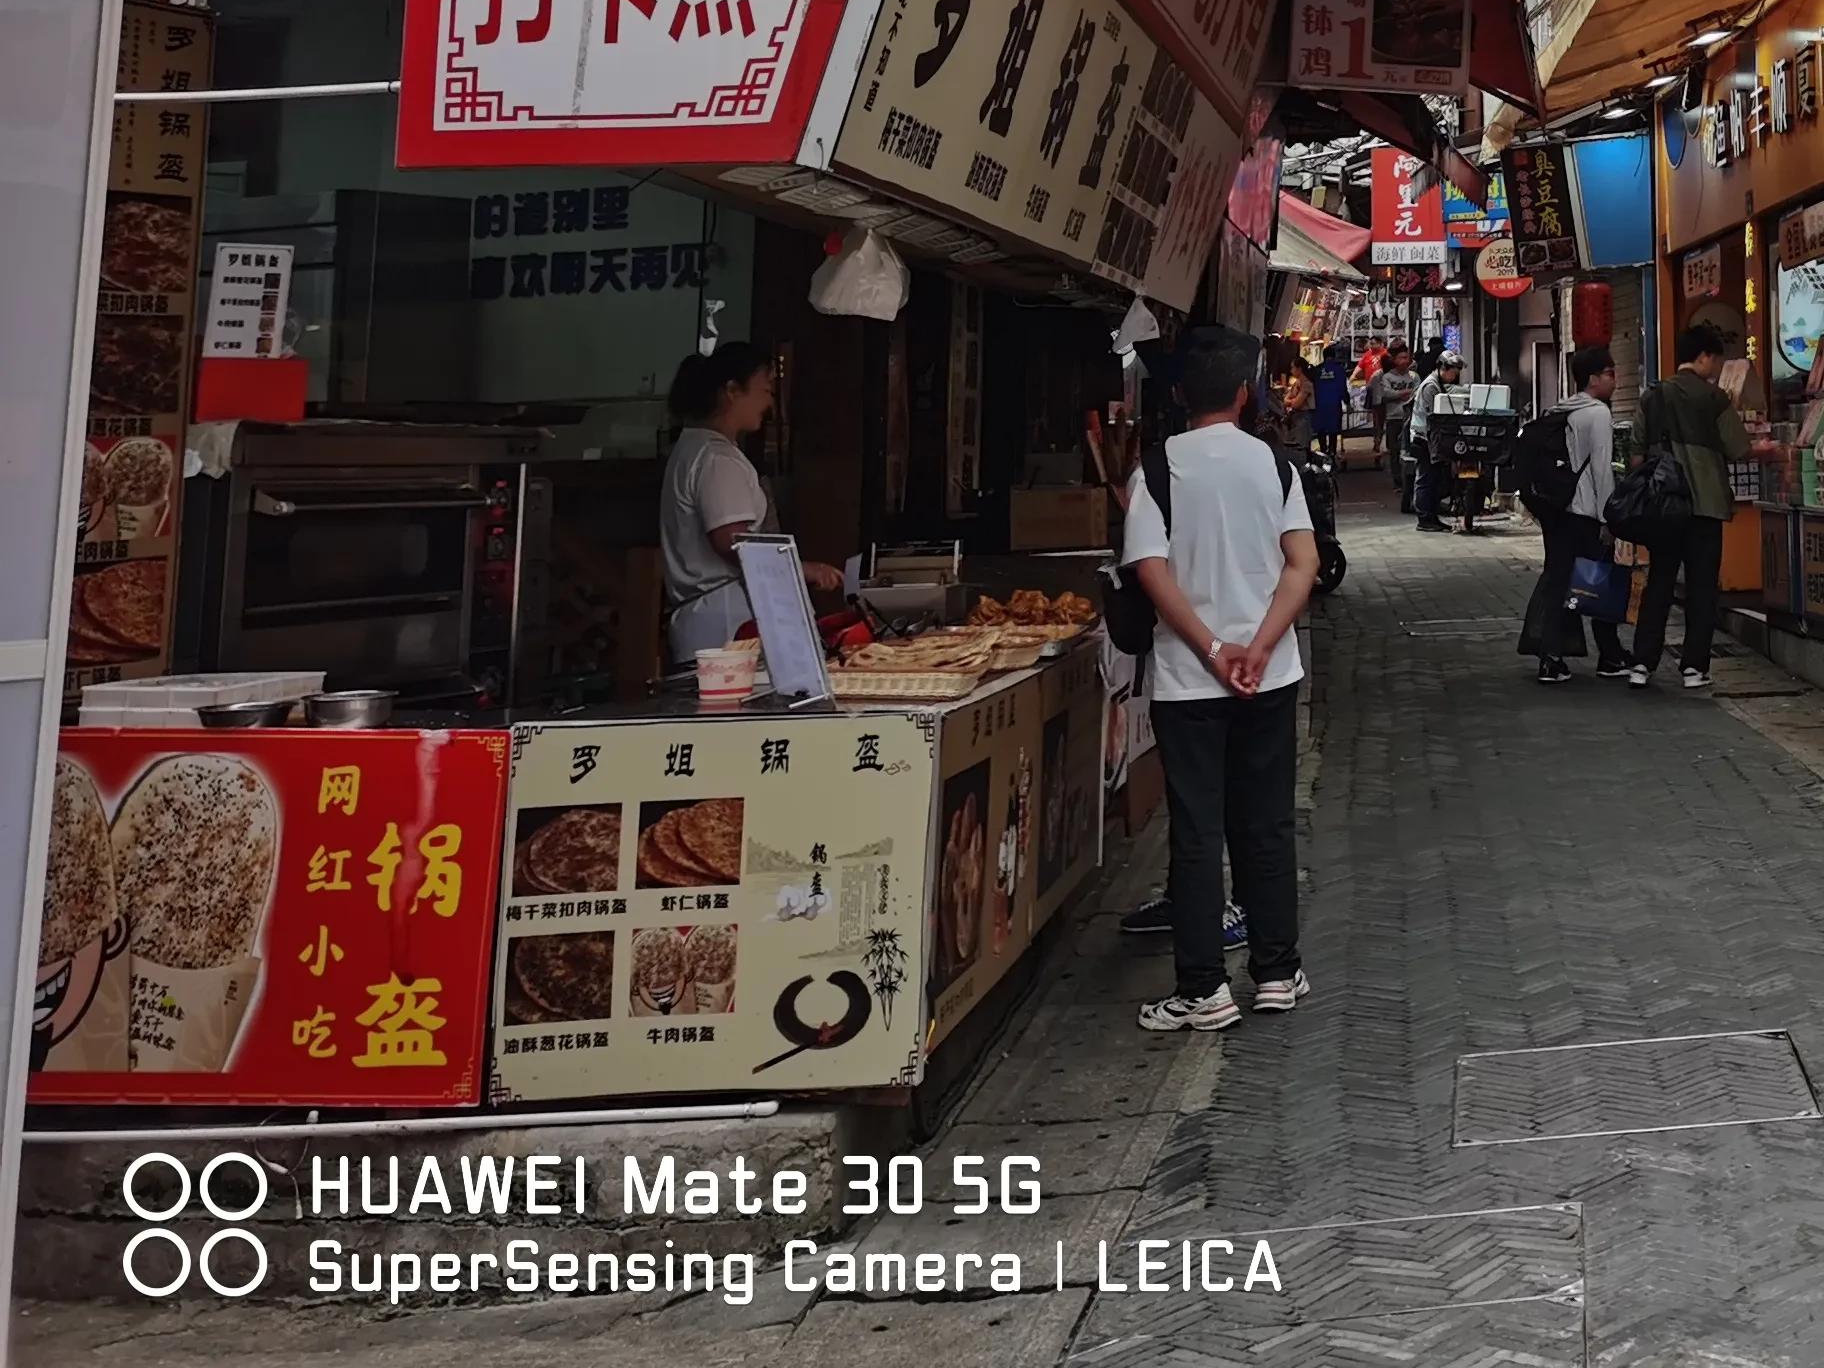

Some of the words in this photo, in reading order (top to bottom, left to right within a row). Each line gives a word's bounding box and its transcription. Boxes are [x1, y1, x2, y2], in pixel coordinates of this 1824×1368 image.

[1530, 150, 1561, 236] 臭豆腐
[570, 733, 884, 784] 罗姐锅盔
[292, 765, 360, 1059] 网红小吃
[506, 898, 627, 922] 梅干菜扣肉锅盔
[660, 893, 729, 912] 虾仁锅盔
[351, 822, 462, 1068] 锅盔
[502, 1032, 609, 1056] 油酥葱花锅盔
[646, 1026, 715, 1044] 牛肉锅盔
